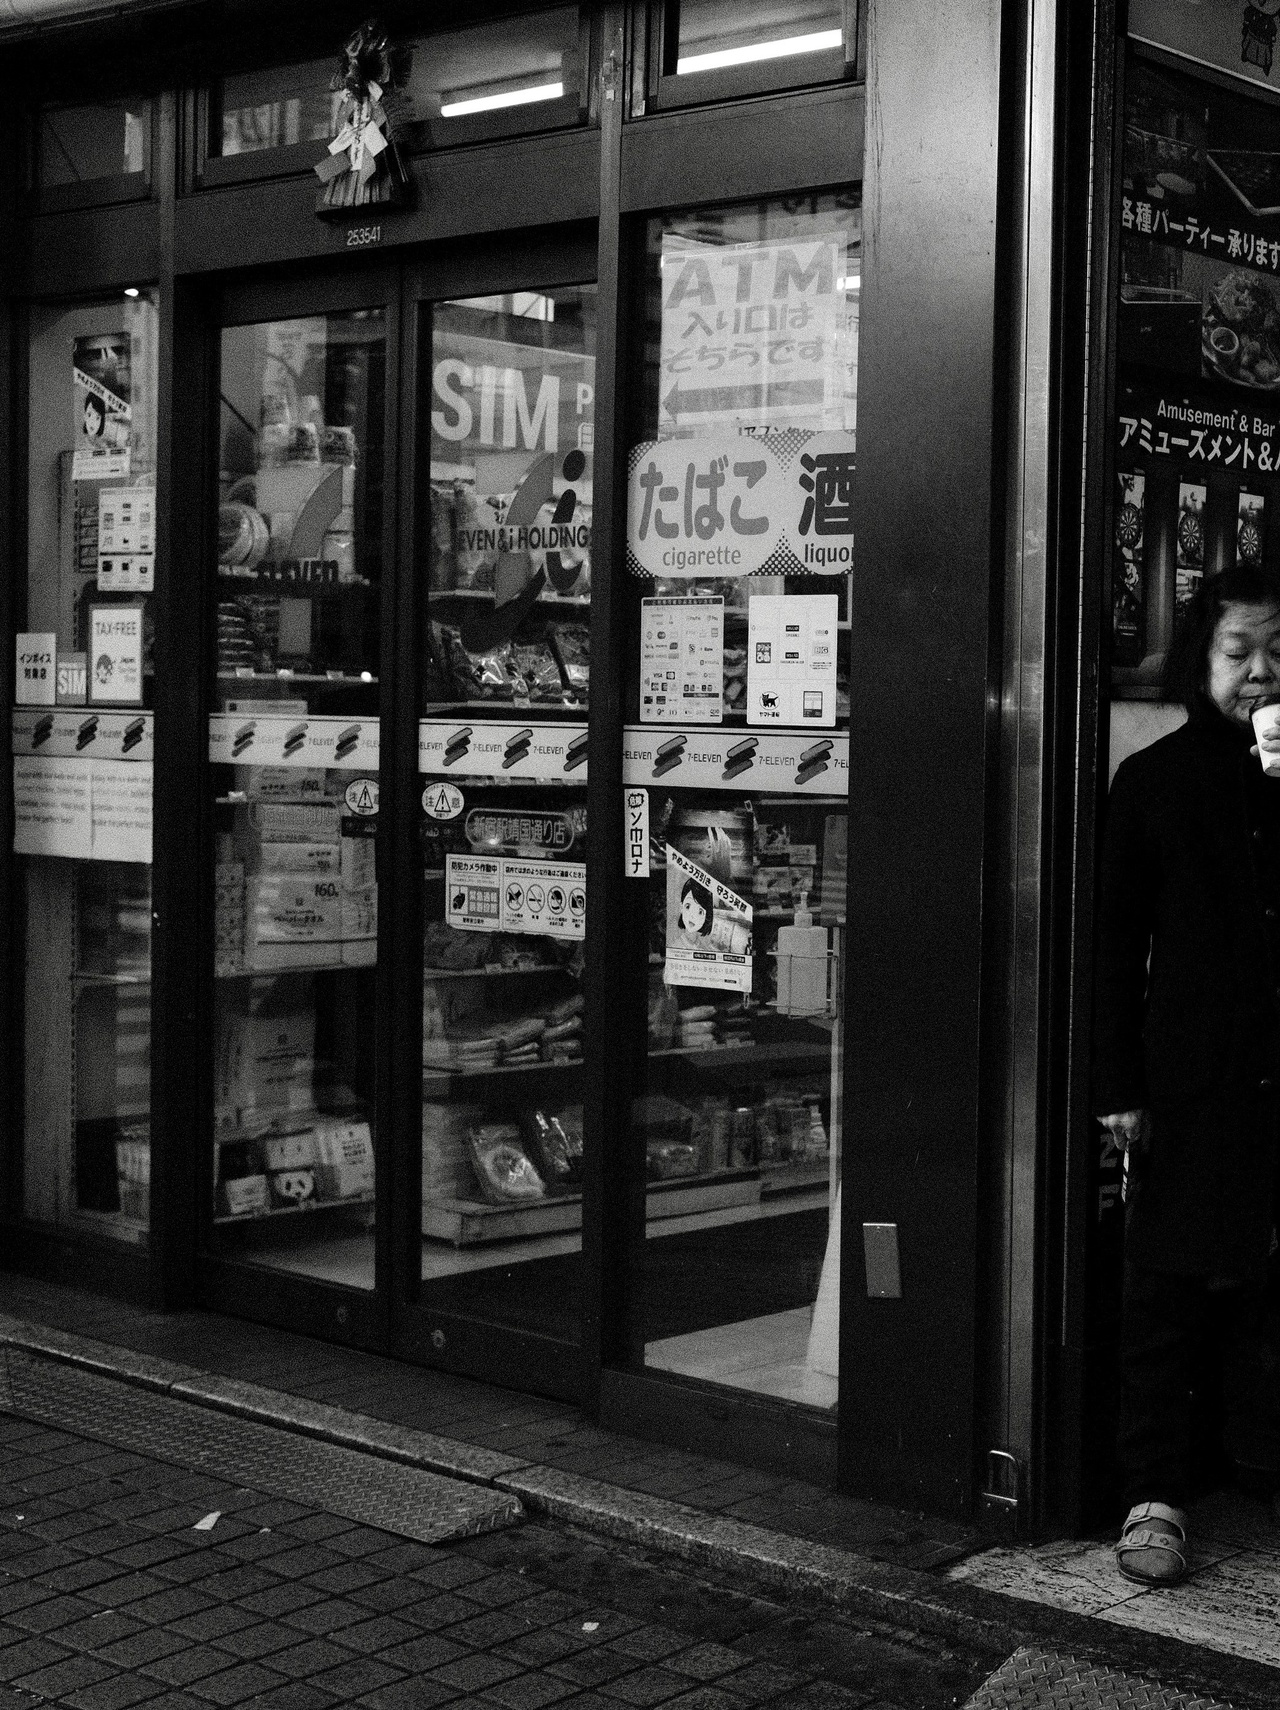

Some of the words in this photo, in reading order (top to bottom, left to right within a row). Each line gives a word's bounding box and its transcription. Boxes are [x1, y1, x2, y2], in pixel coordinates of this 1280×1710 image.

[346, 225, 382, 247] 253541
[664, 242, 836, 310] ATM
[681, 301, 814, 340] 入り口は
[431, 358, 560, 453] SIM
[1156, 398, 1237, 432] Amusement
[1238, 416, 1249, 434] &
[1252, 416, 1276, 438] Bar
[638, 454, 771, 542] たばこ
[797, 451, 857, 538] 酒
[517, 524, 593, 553] HOLDING
[662, 546, 742, 570] cigarette
[95, 621, 137, 636] TAX-FREE
